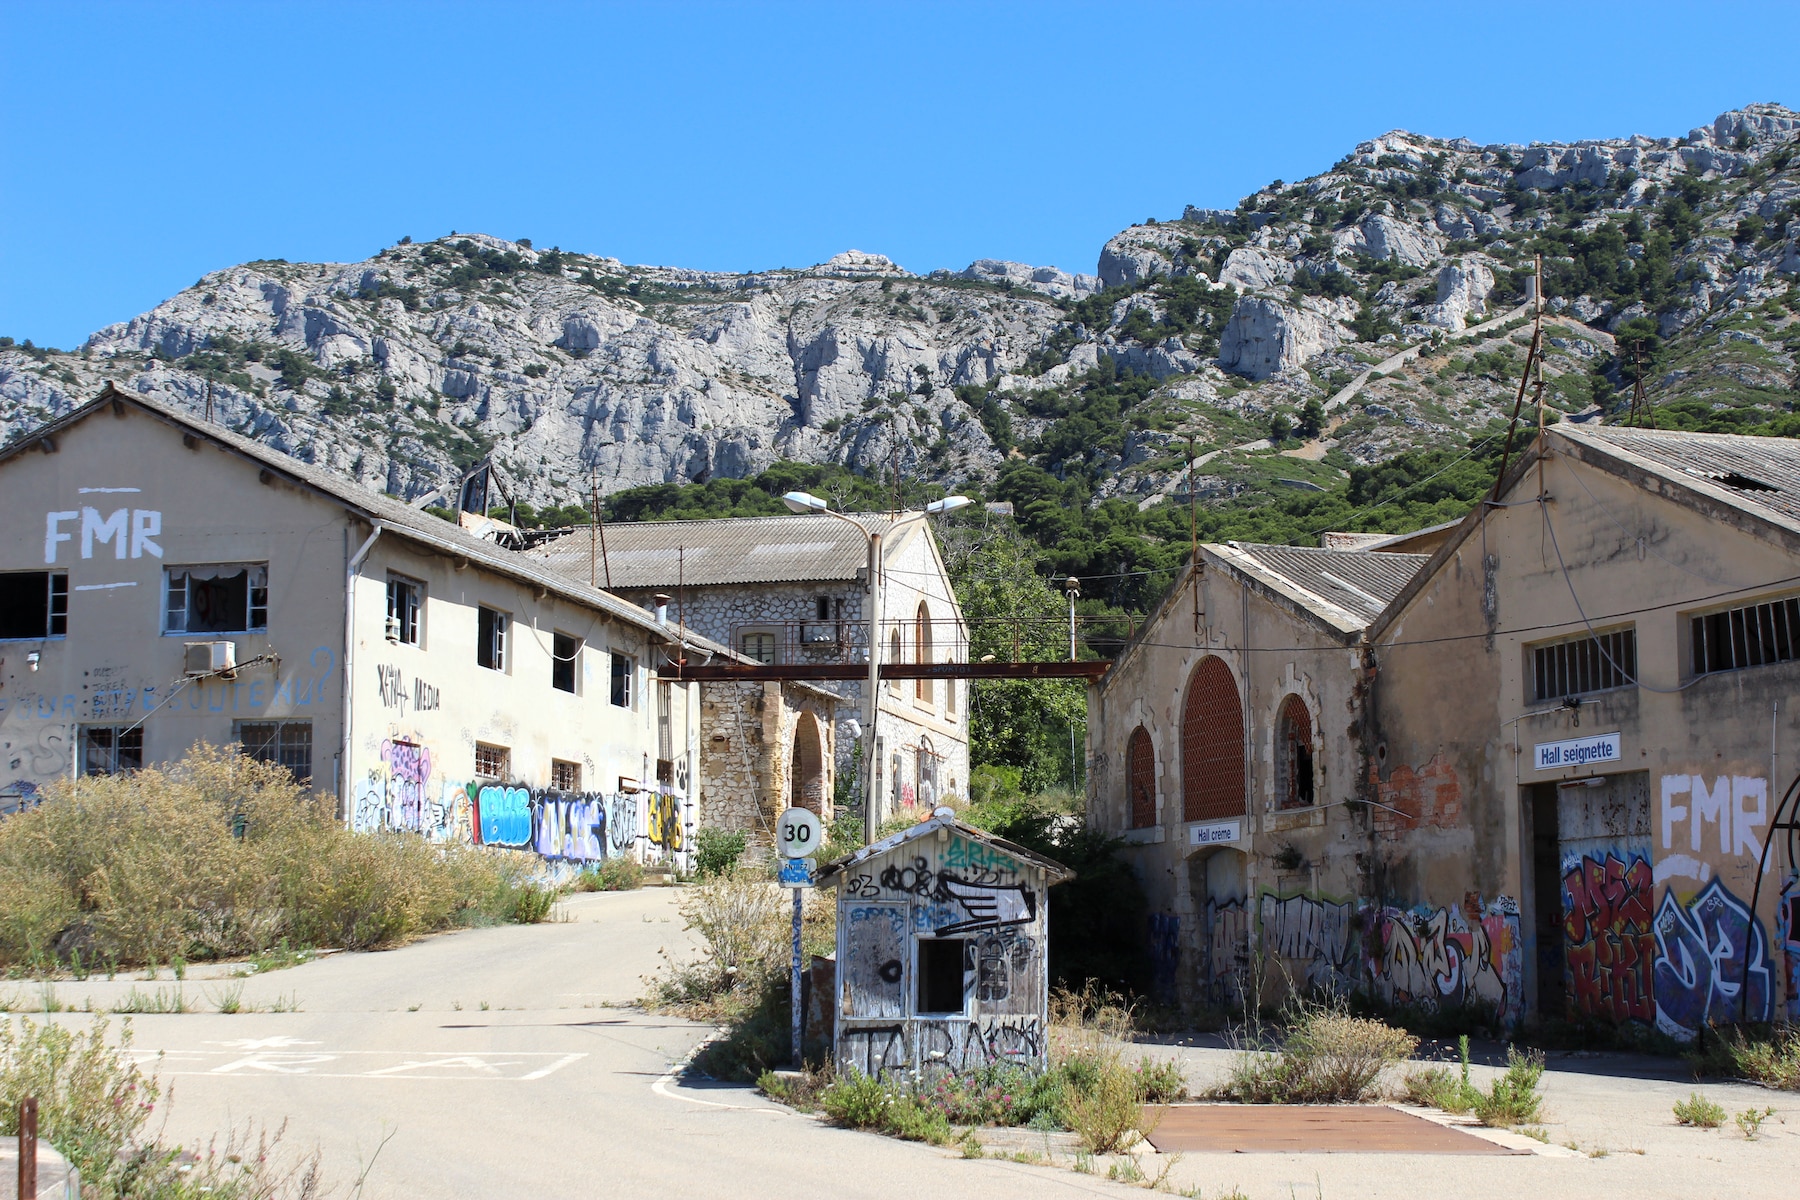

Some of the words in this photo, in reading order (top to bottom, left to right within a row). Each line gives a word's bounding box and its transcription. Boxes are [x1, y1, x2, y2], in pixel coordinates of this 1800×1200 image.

[44, 506, 163, 563] FMR
[1541, 746, 1560, 765] Hall
[1563, 740, 1613, 764] seignette
[784, 824, 811, 842] 30
[1198, 828, 1210, 842] Hall
[1211, 827, 1231, 841] crème
[1661, 773, 1773, 874] FMR
